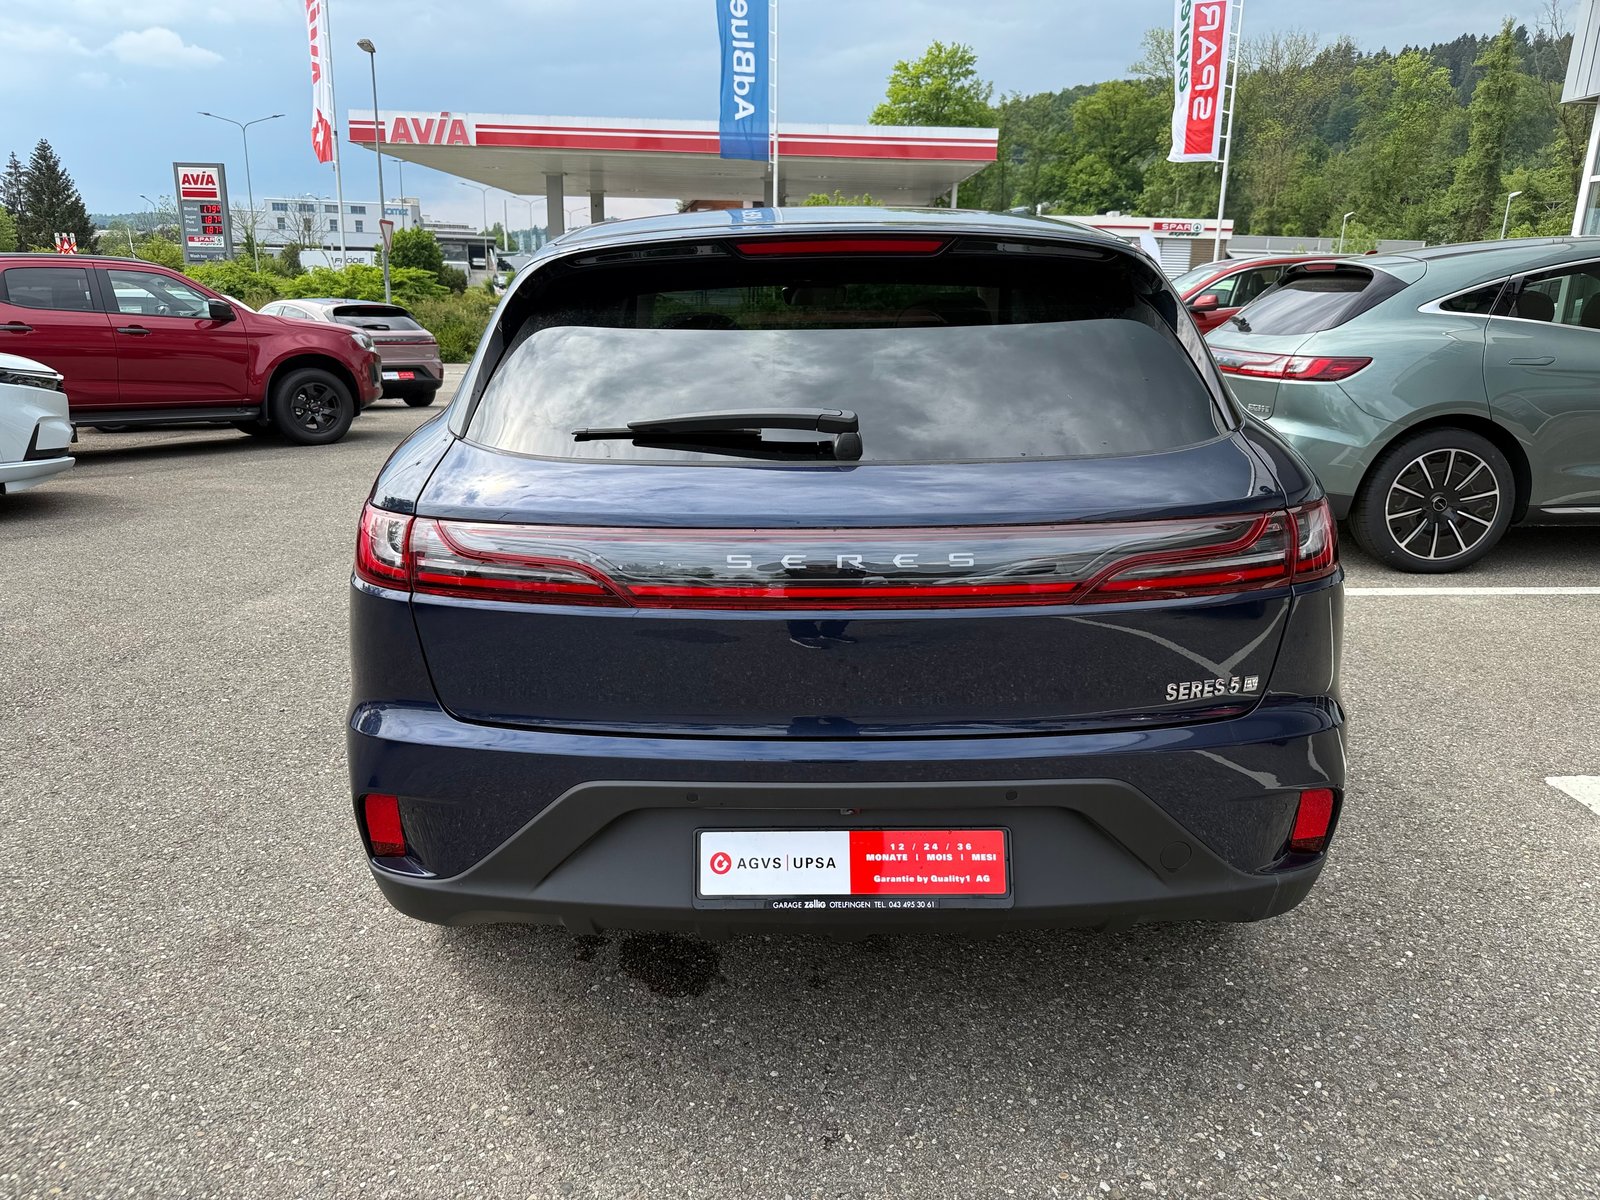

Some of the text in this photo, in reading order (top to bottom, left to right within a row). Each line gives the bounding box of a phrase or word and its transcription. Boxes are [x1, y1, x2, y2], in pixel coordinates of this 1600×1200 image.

[726, 552, 975, 569] SERES
[1165, 678, 1226, 701] SERES
[1229, 676, 1240, 694] 5
[737, 857, 836, 869] AGVS UPSA
[873, 875, 990, 884] Garantie by Quality1 AG
